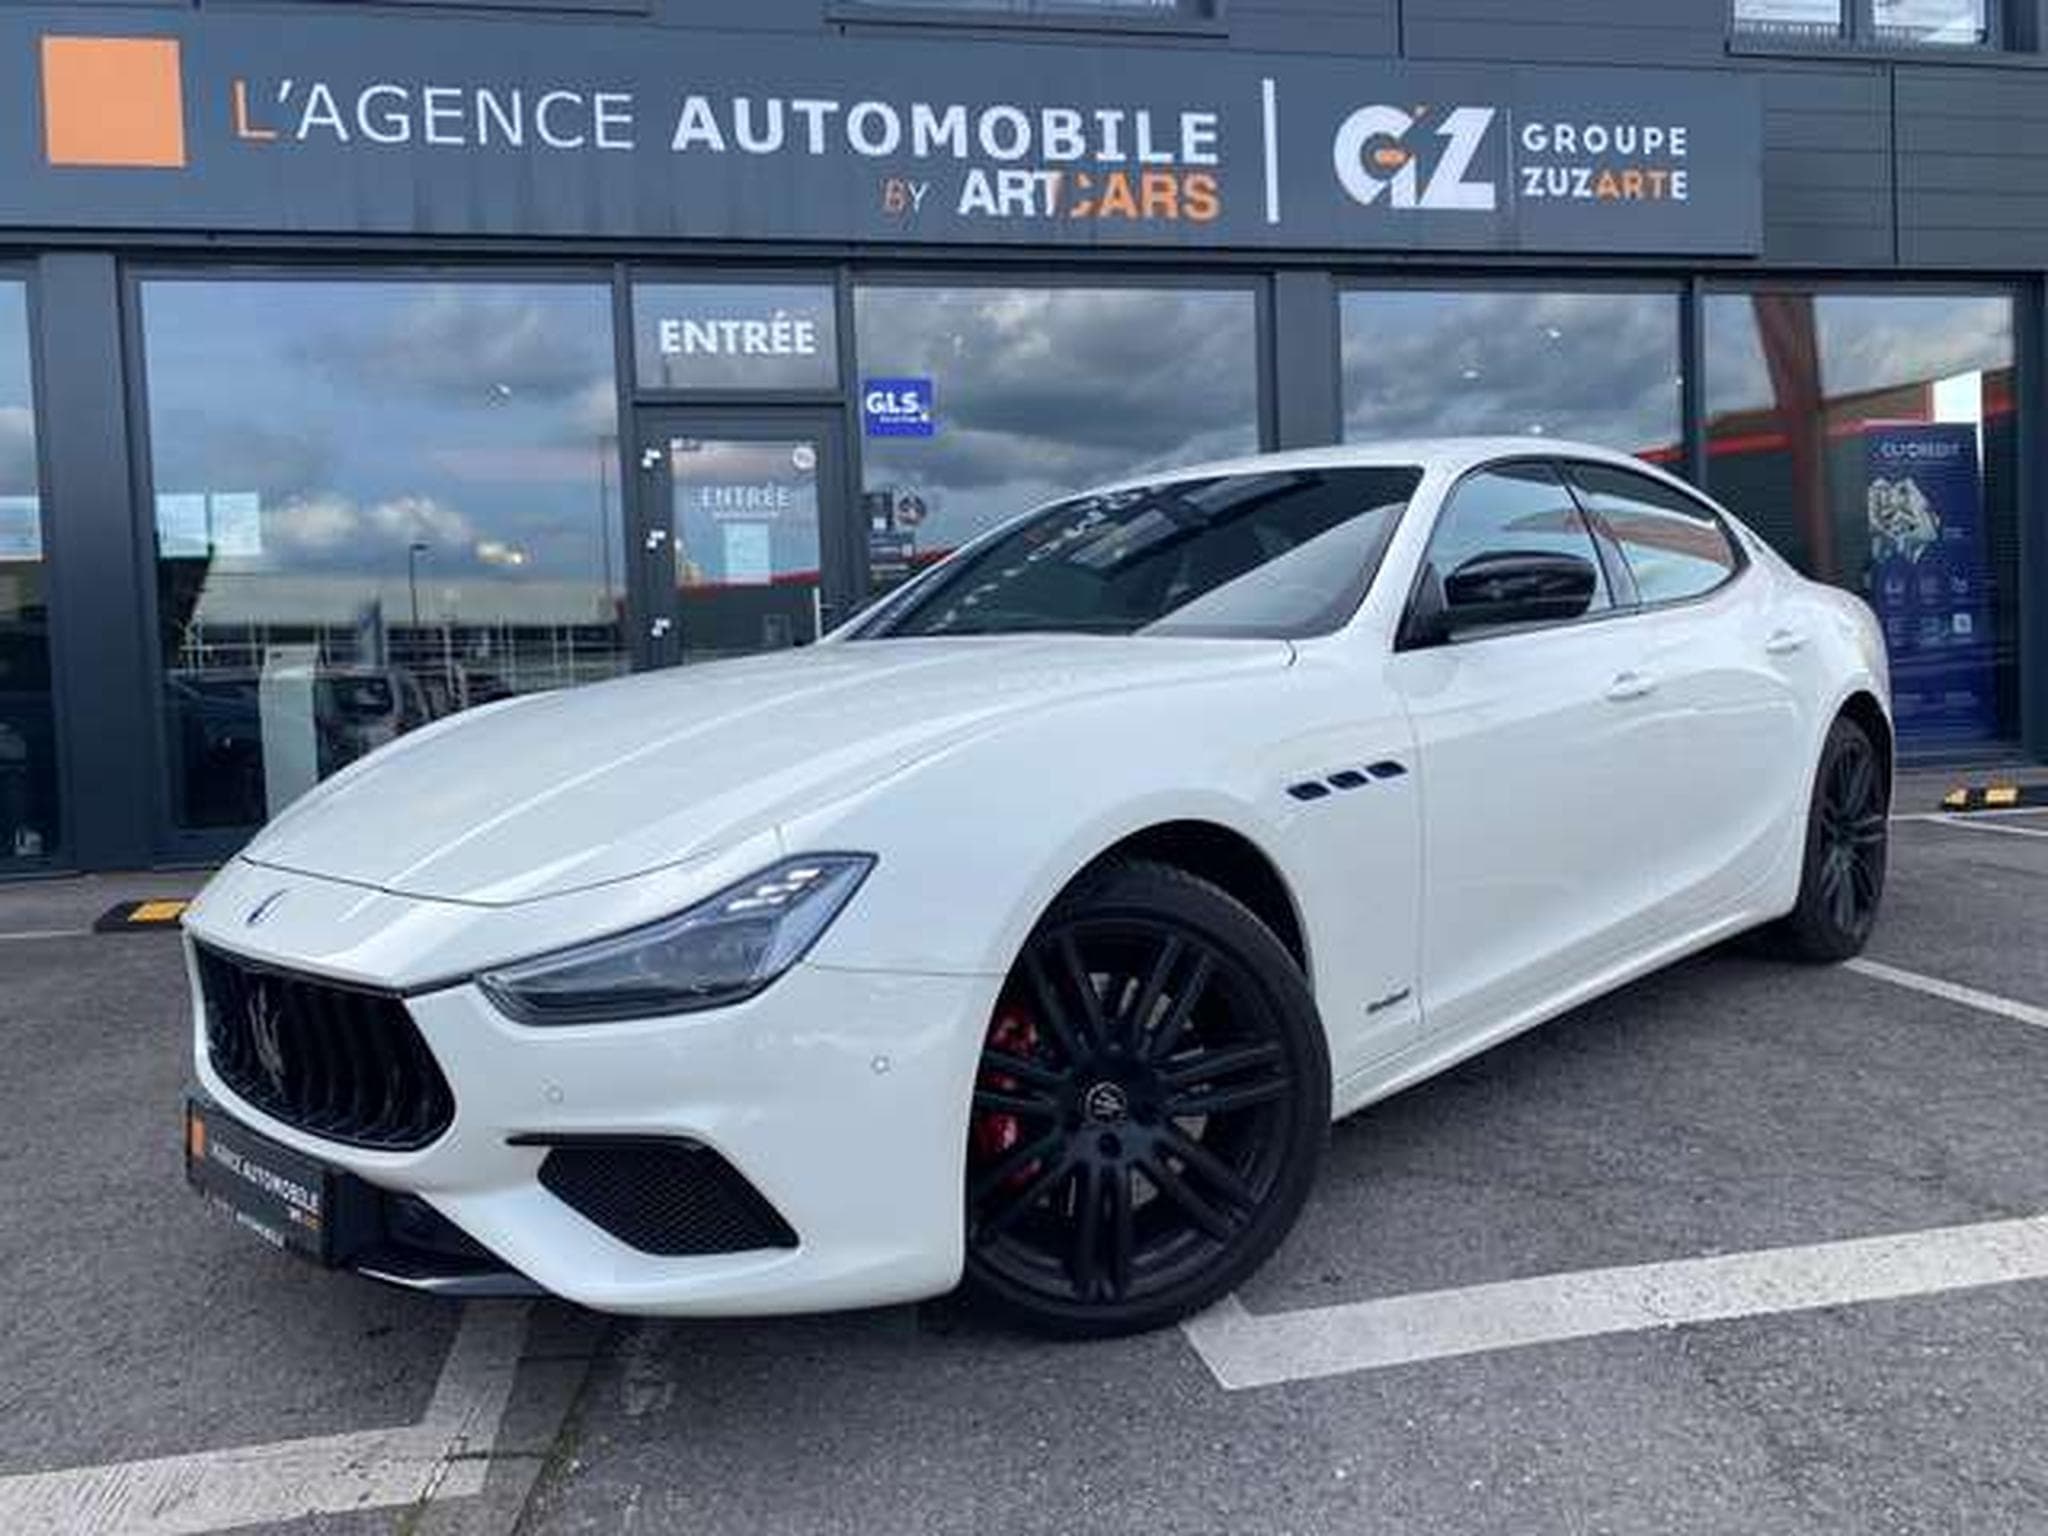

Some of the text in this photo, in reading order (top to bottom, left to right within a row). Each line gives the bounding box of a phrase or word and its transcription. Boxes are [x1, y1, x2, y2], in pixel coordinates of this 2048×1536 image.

[233, 80, 1219, 165] L'AGENCE AUTOMOBILE
[1521, 123, 1688, 156] GROUPE
[884, 178, 929, 212] BY
[1521, 167, 1688, 200] ZUZARTE
[659, 310, 816, 354] ENTRÉE
